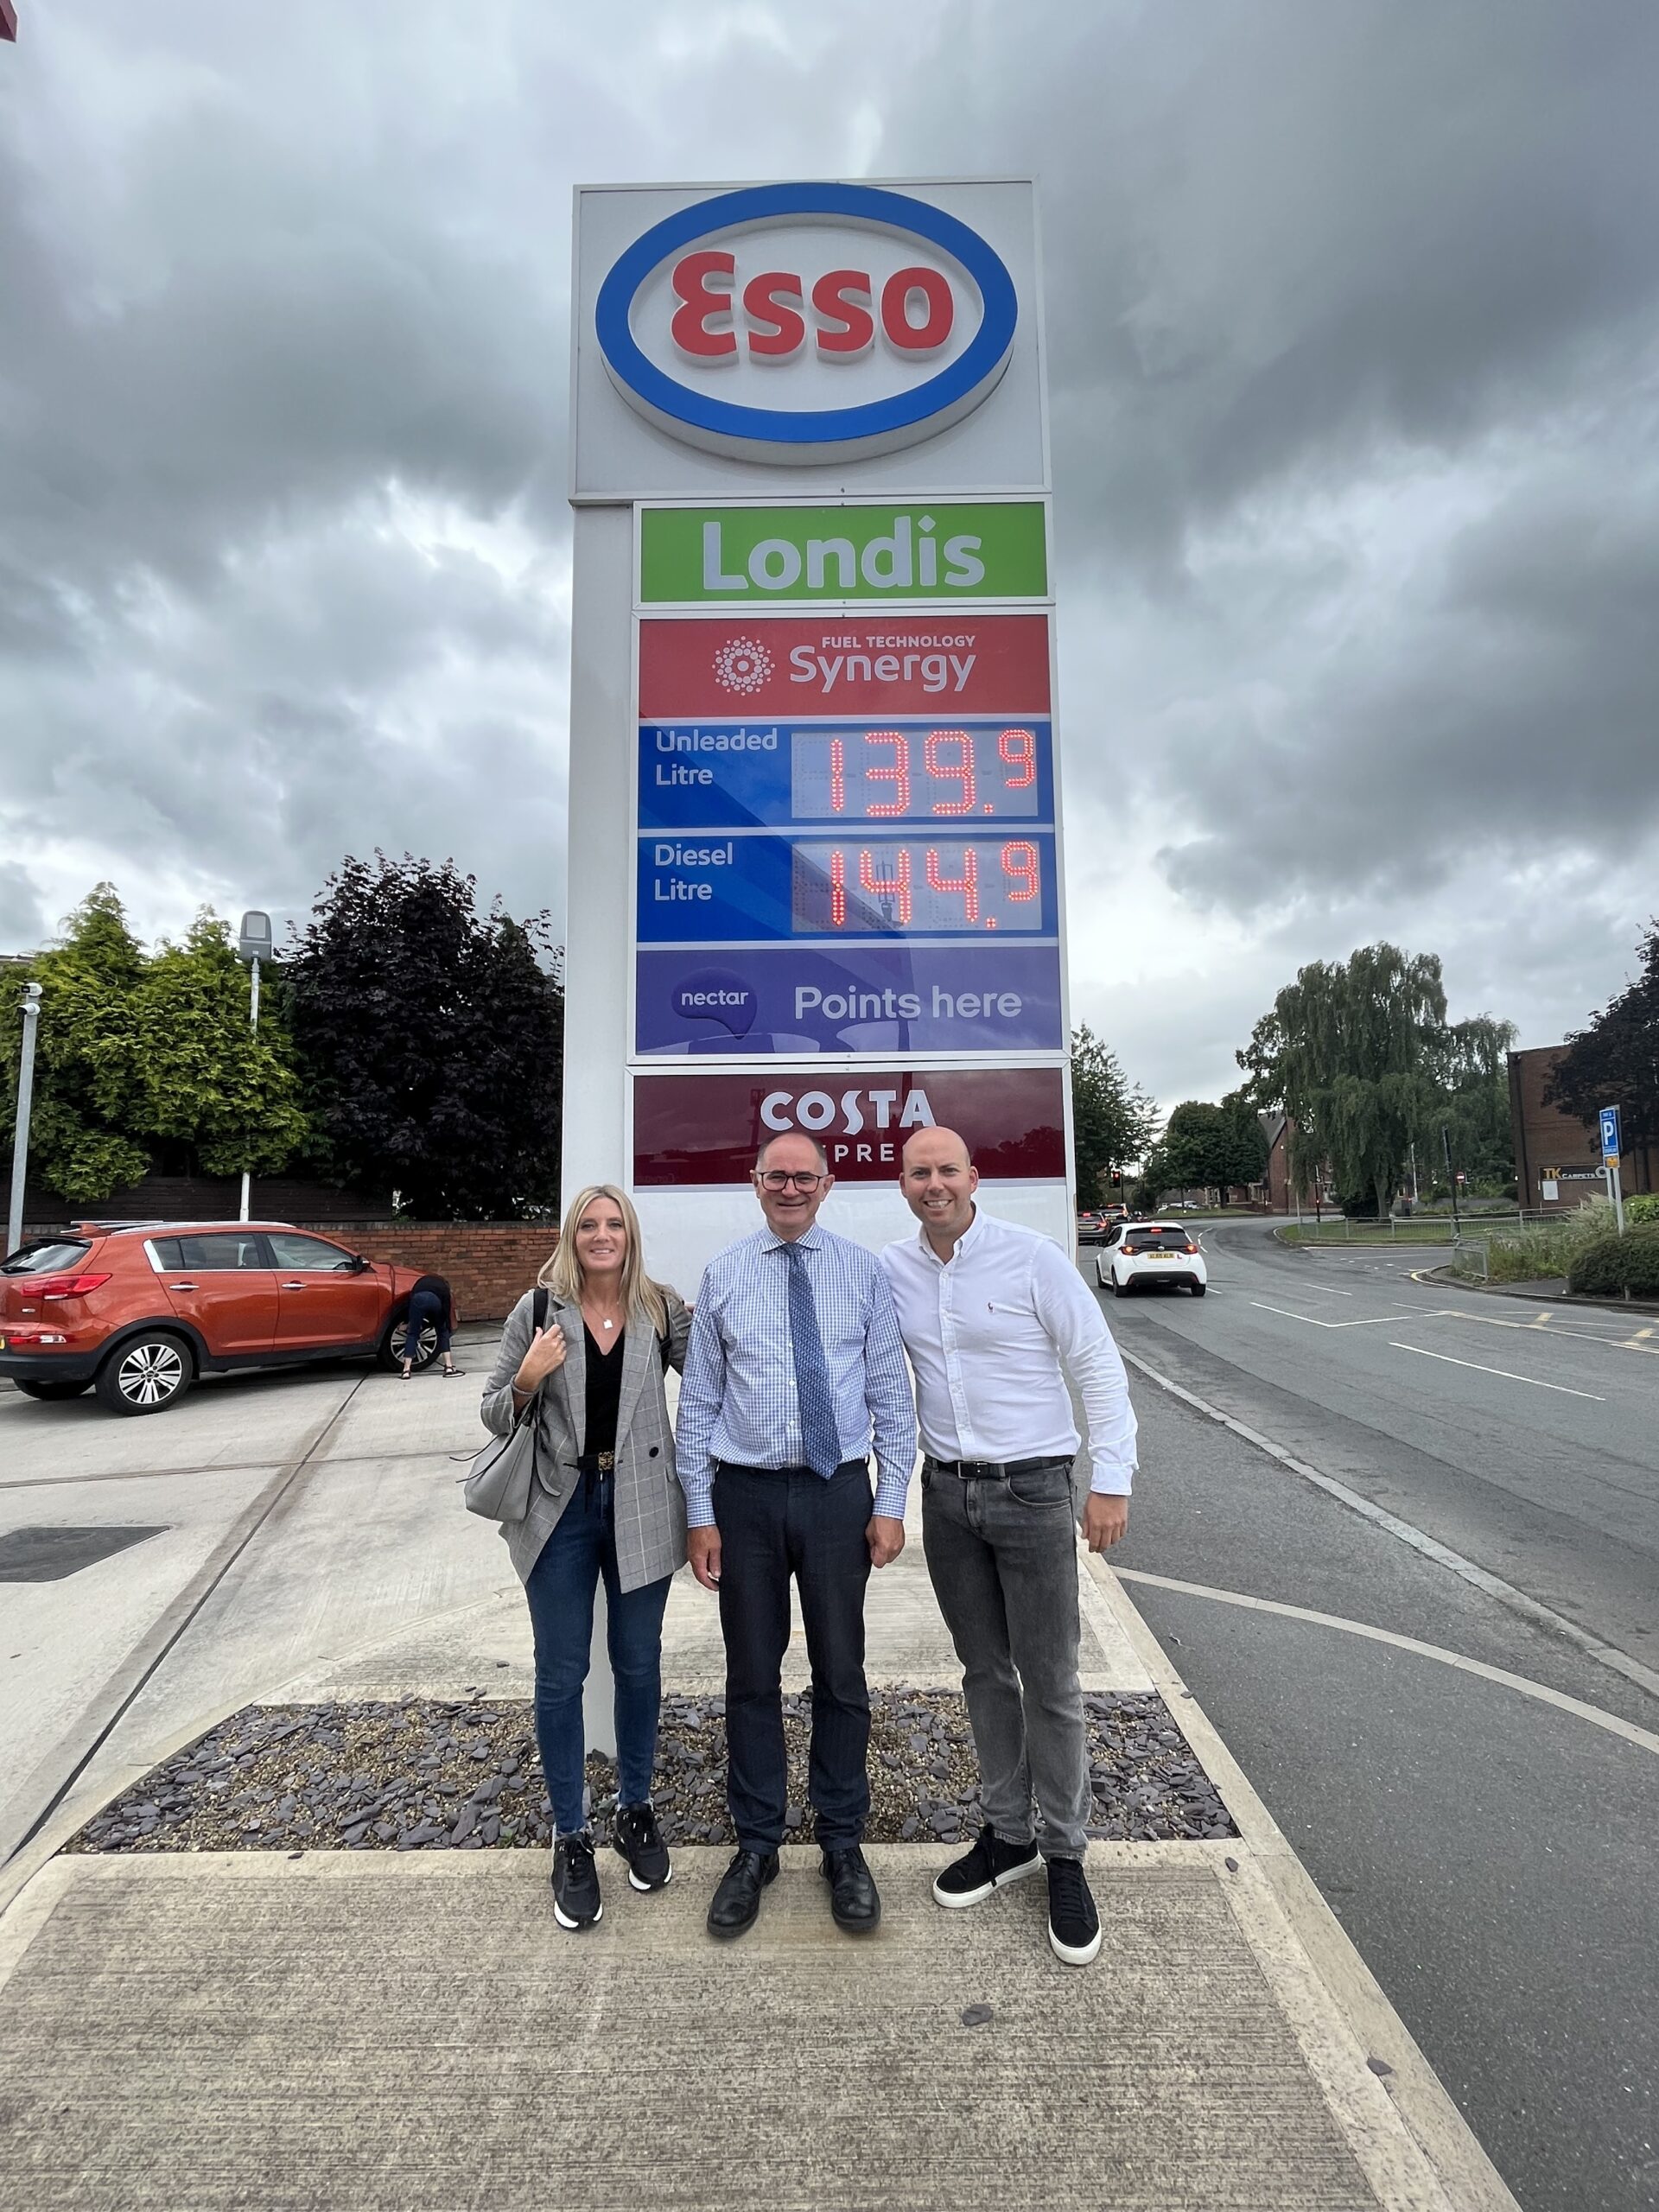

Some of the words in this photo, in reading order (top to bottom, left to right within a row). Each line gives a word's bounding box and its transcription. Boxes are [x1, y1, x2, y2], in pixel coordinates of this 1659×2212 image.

[702, 515, 985, 591] Londis
[822, 636, 861, 648] FUEL
[866, 635, 976, 649] TECHNOLOGY
[789, 645, 976, 693] Synergy
[655, 728, 778, 753] Unleaded
[655, 764, 714, 786] Litre
[654, 842, 734, 867] Diesel
[653, 878, 713, 902] Litre
[680, 988, 749, 1007] nectar
[794, 985, 921, 1020] Points
[931, 985, 1023, 1019] here
[760, 1089, 938, 1135] COSTA
[1603, 1121, 1614, 1145] P
